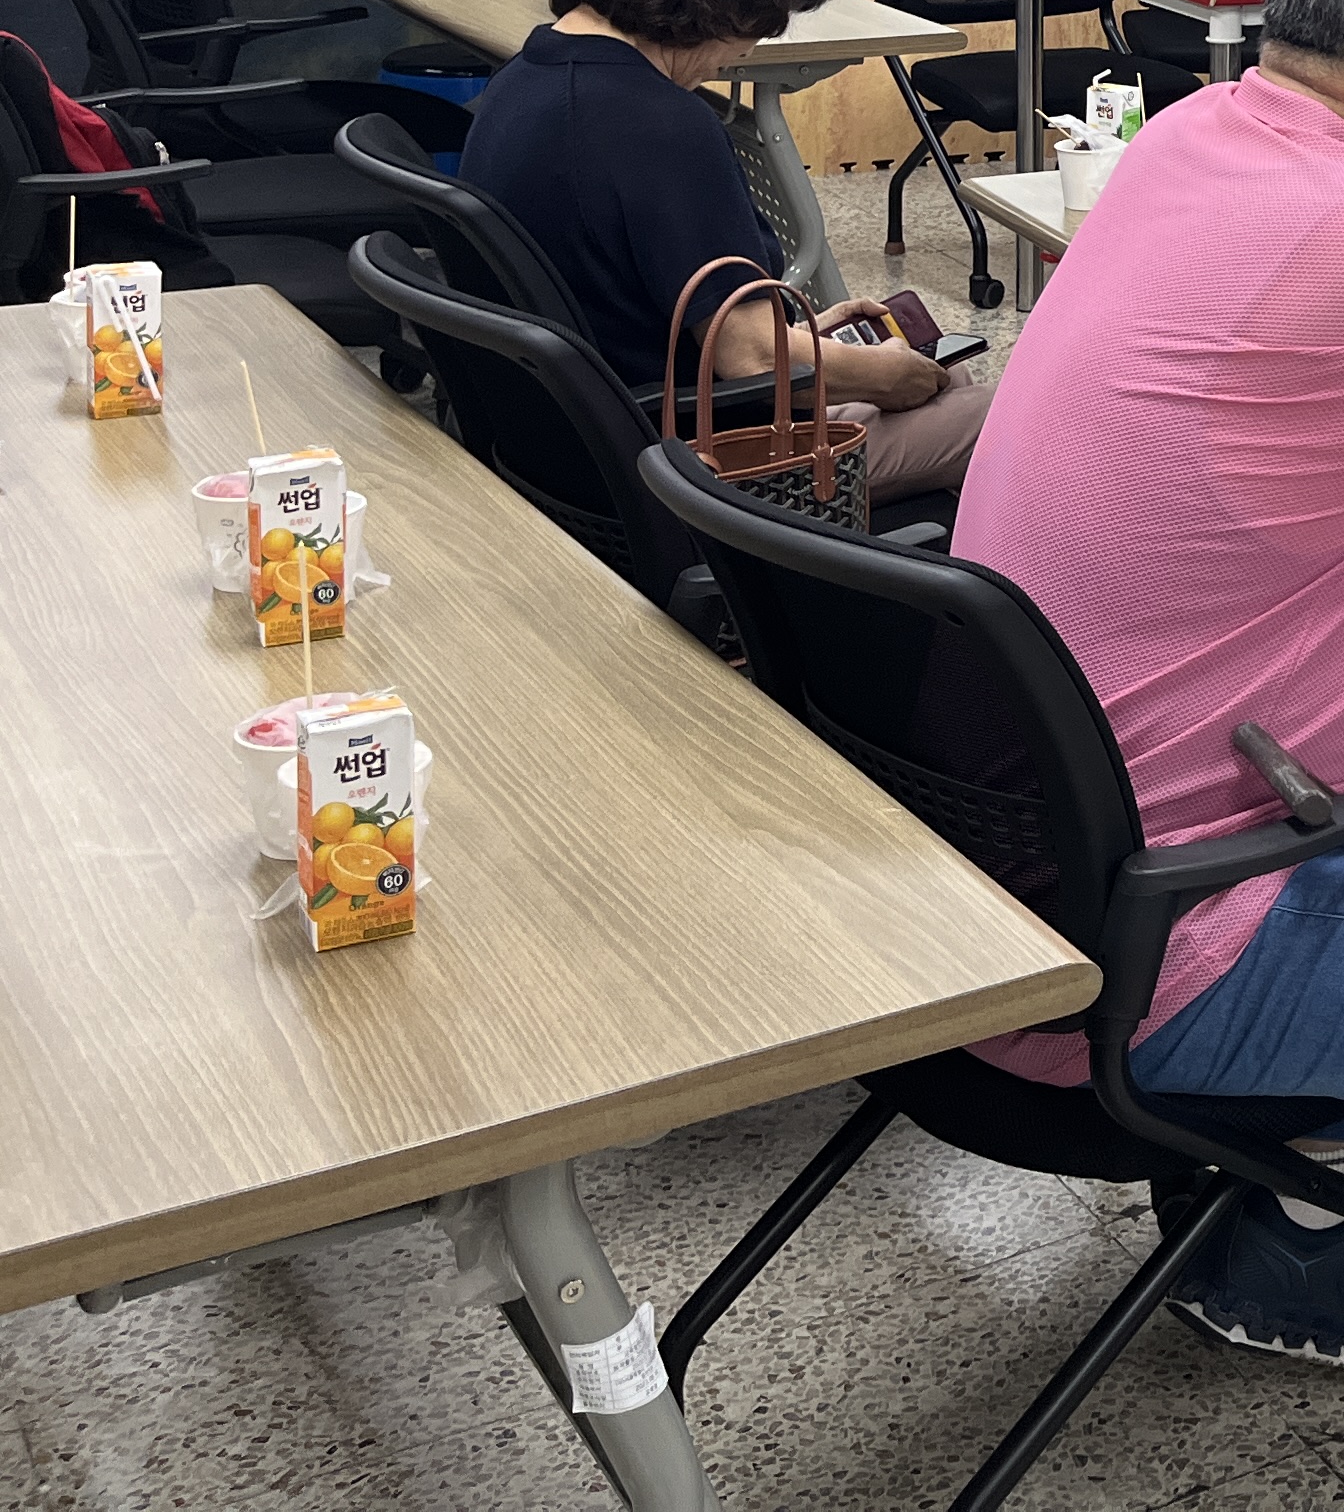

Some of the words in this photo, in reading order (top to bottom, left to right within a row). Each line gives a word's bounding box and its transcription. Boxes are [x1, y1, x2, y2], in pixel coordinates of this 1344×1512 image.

[277, 488, 321, 513] 썬업
[319, 588, 334, 599] 60
[333, 748, 386, 783] 썬업
[348, 786, 376, 799] 오렌지
[384, 874, 403, 888] 60
